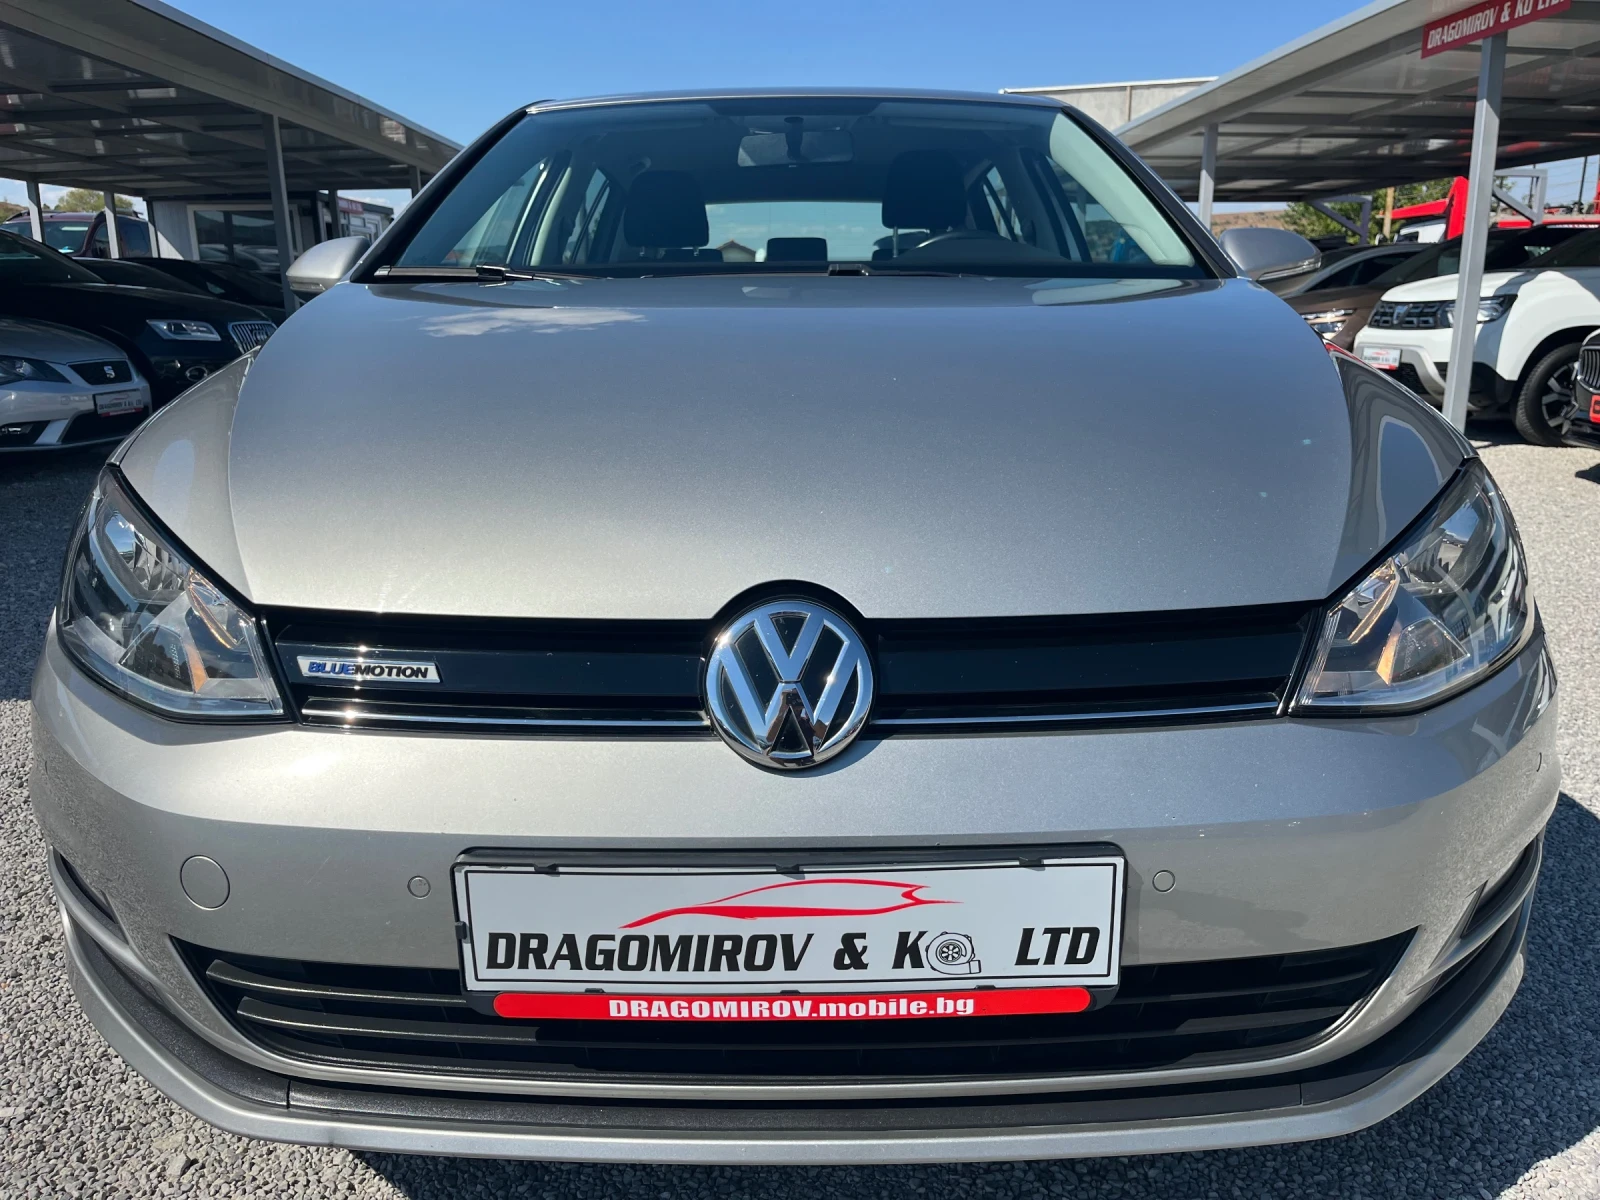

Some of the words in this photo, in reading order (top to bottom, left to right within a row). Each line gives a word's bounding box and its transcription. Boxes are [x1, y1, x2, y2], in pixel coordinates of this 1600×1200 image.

[1427, 6, 1500, 50] DRAGOMIROV
[1500, 2, 1512, 24] &
[308, 661, 429, 679] BLUEMOTION
[487, 933, 814, 972] DRAGOMIROV
[834, 933, 868, 971] &
[1015, 927, 1100, 965] LTD
[608, 998, 974, 1018] DRAGOMIROV.mobile.bg
